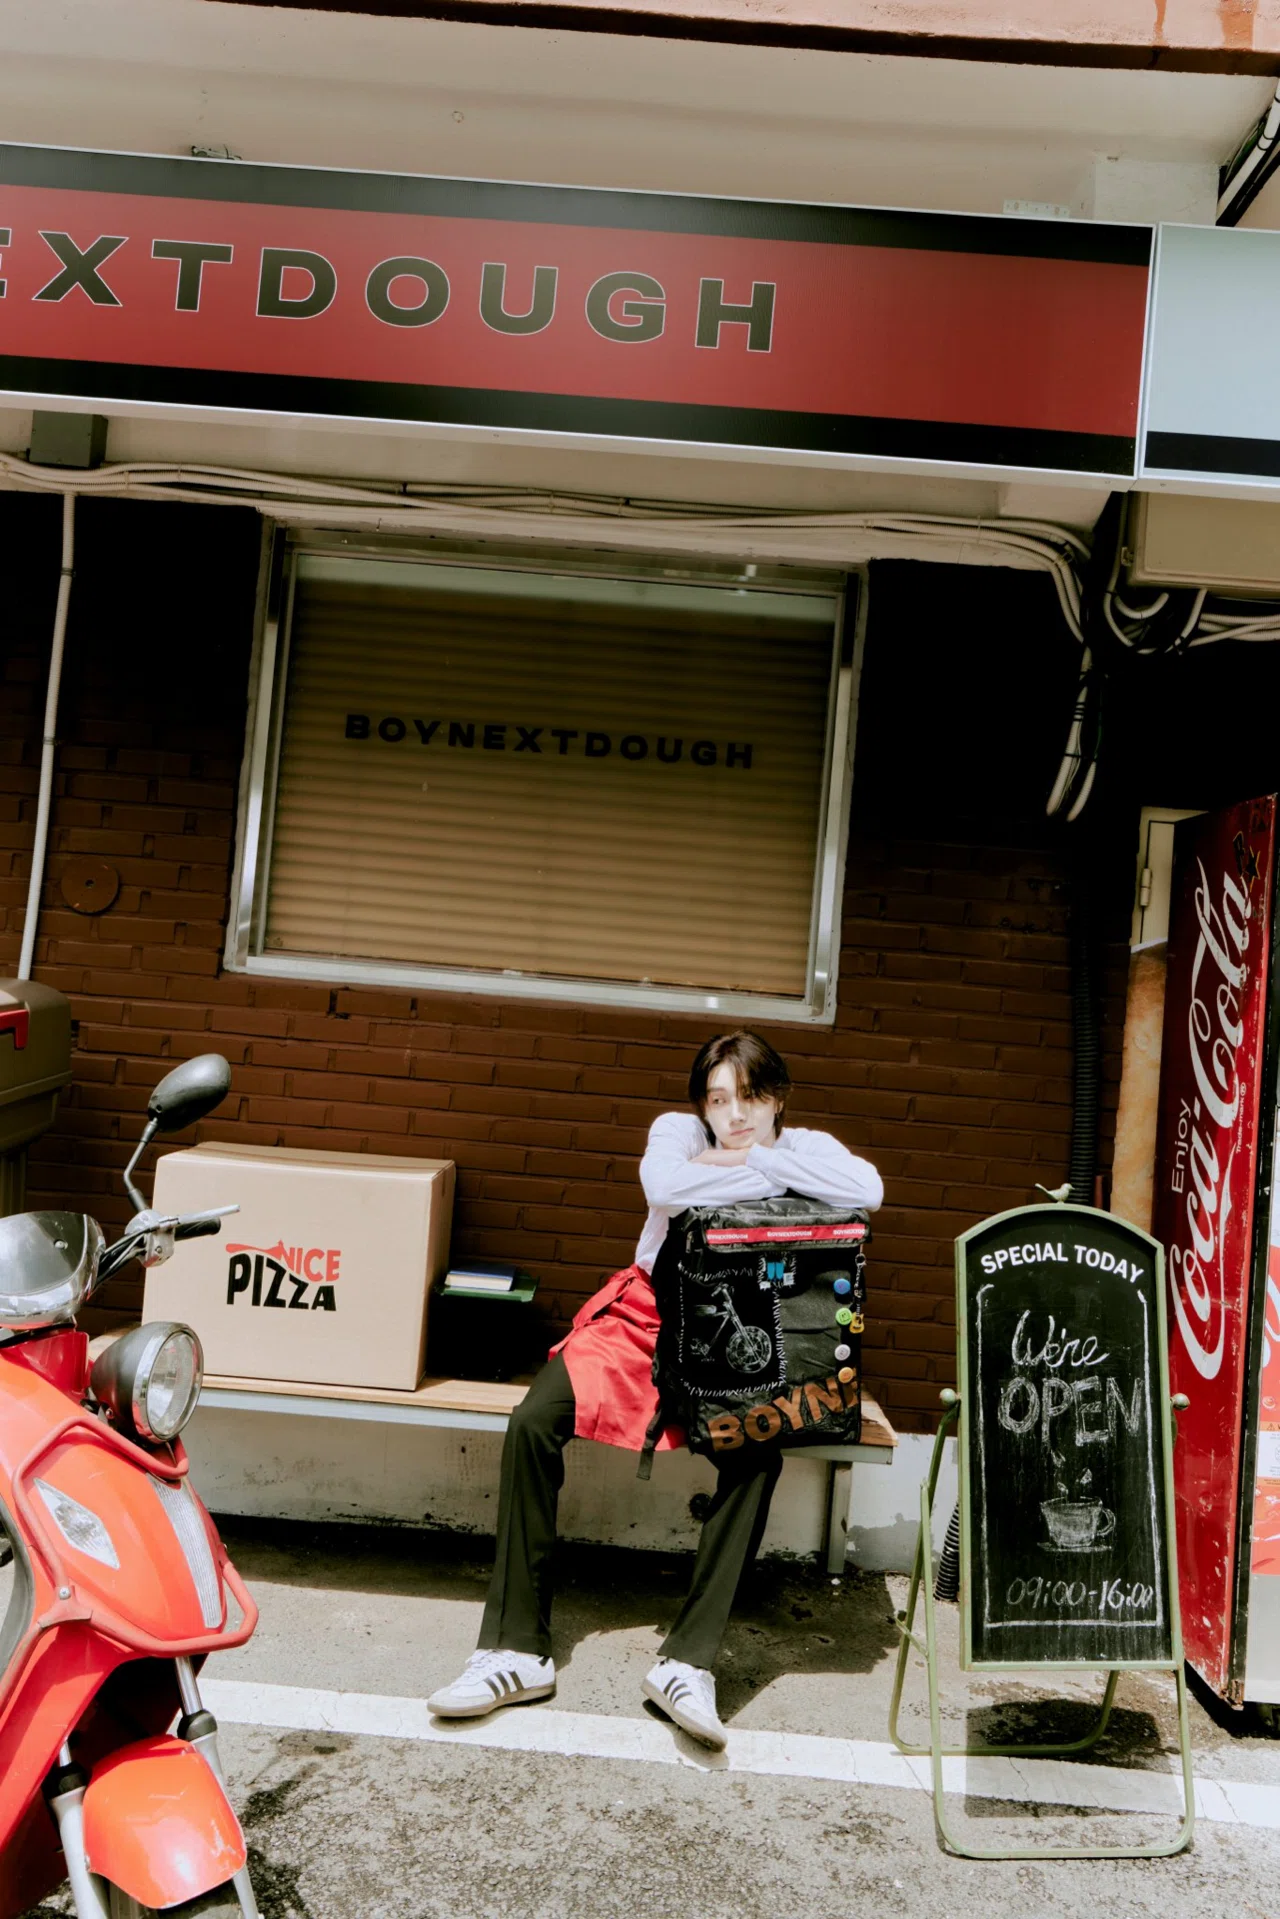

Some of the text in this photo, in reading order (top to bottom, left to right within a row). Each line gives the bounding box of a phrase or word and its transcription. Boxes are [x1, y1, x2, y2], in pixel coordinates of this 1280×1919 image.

[0, 228, 776, 353] XTDOUGH
[345, 713, 753, 769] BOYNEXTDOUGH
[1169, 856, 1252, 1380] Coca-Cola
[1171, 1098, 1191, 1193] Enjoy
[226, 1253, 336, 1311] PIZZA
[276, 1240, 341, 1283] NICE
[981, 1242, 1144, 1284] SPECIAL TODAY
[1011, 1309, 1110, 1368] We're
[998, 1375, 1144, 1446] OPEN
[1006, 1576, 1154, 1611] 09:00-16:00
